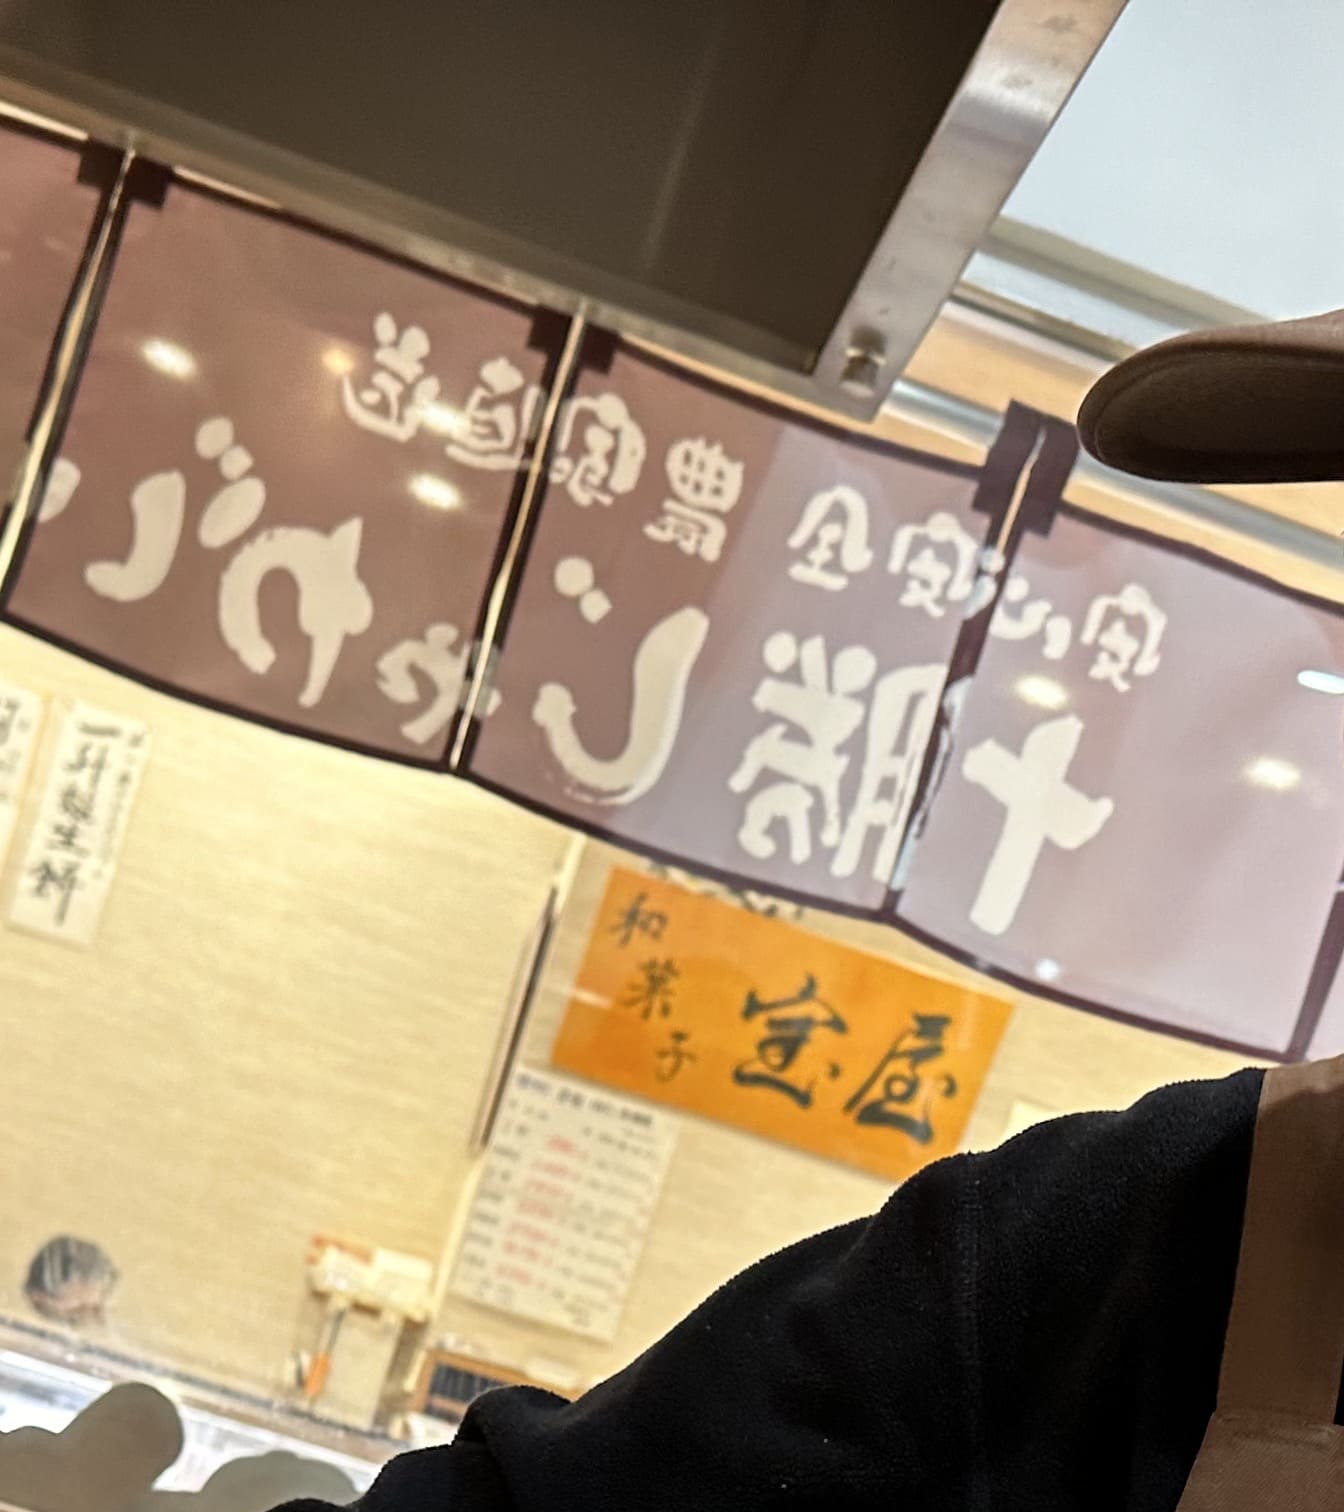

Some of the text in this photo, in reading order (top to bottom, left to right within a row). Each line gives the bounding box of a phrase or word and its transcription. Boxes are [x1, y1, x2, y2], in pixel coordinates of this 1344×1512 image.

[611, 894, 698, 1082] 和菓子
[732, 972, 959, 1148] 宝屋
